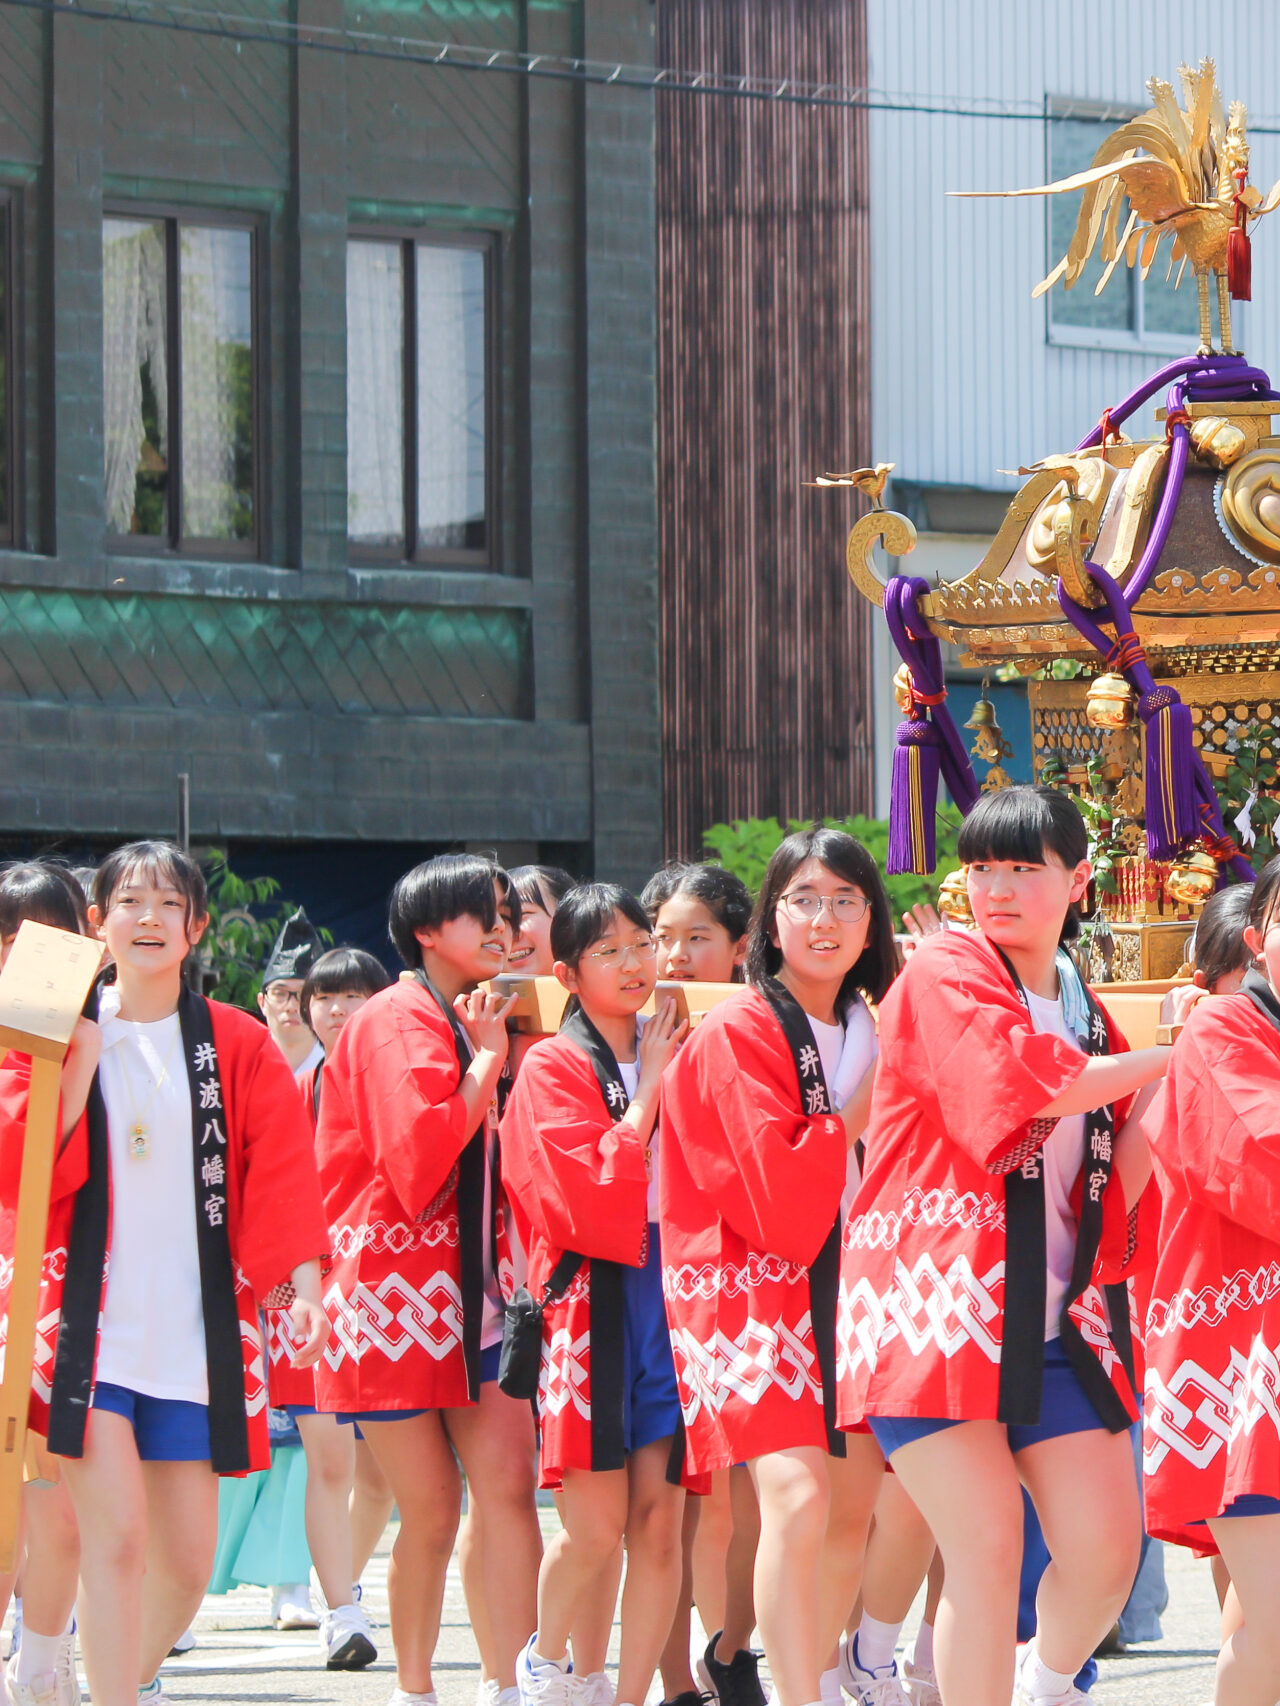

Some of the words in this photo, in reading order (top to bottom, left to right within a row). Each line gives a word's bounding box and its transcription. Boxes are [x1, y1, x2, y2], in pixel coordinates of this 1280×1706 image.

[193, 1042, 227, 1227] 井波八幡宮
[799, 1044, 829, 1115] 井波
